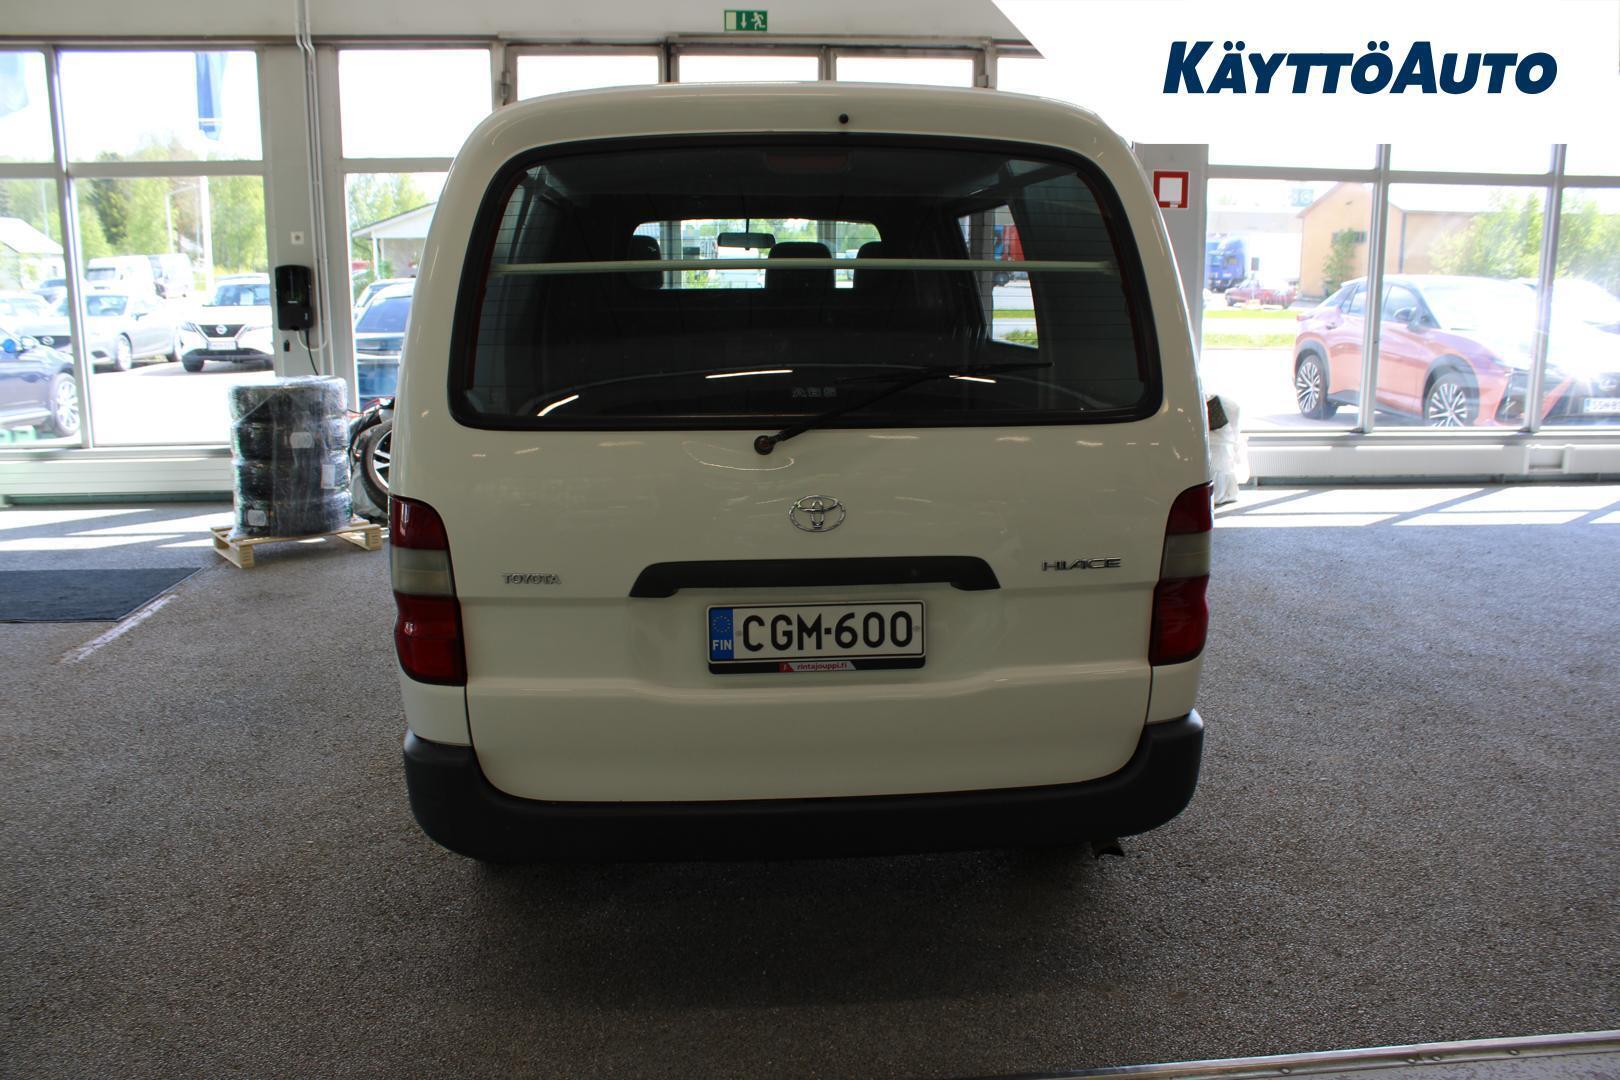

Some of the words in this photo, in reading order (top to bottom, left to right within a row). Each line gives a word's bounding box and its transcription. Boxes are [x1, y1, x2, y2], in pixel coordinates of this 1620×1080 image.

[1041, 557, 1121, 571] HIACE
[502, 573, 562, 585] TOYOTA
[742, 610, 913, 652] CGM-600
[712, 639, 732, 651] FIN
[796, 661, 847, 671] rintajouppi.fi
